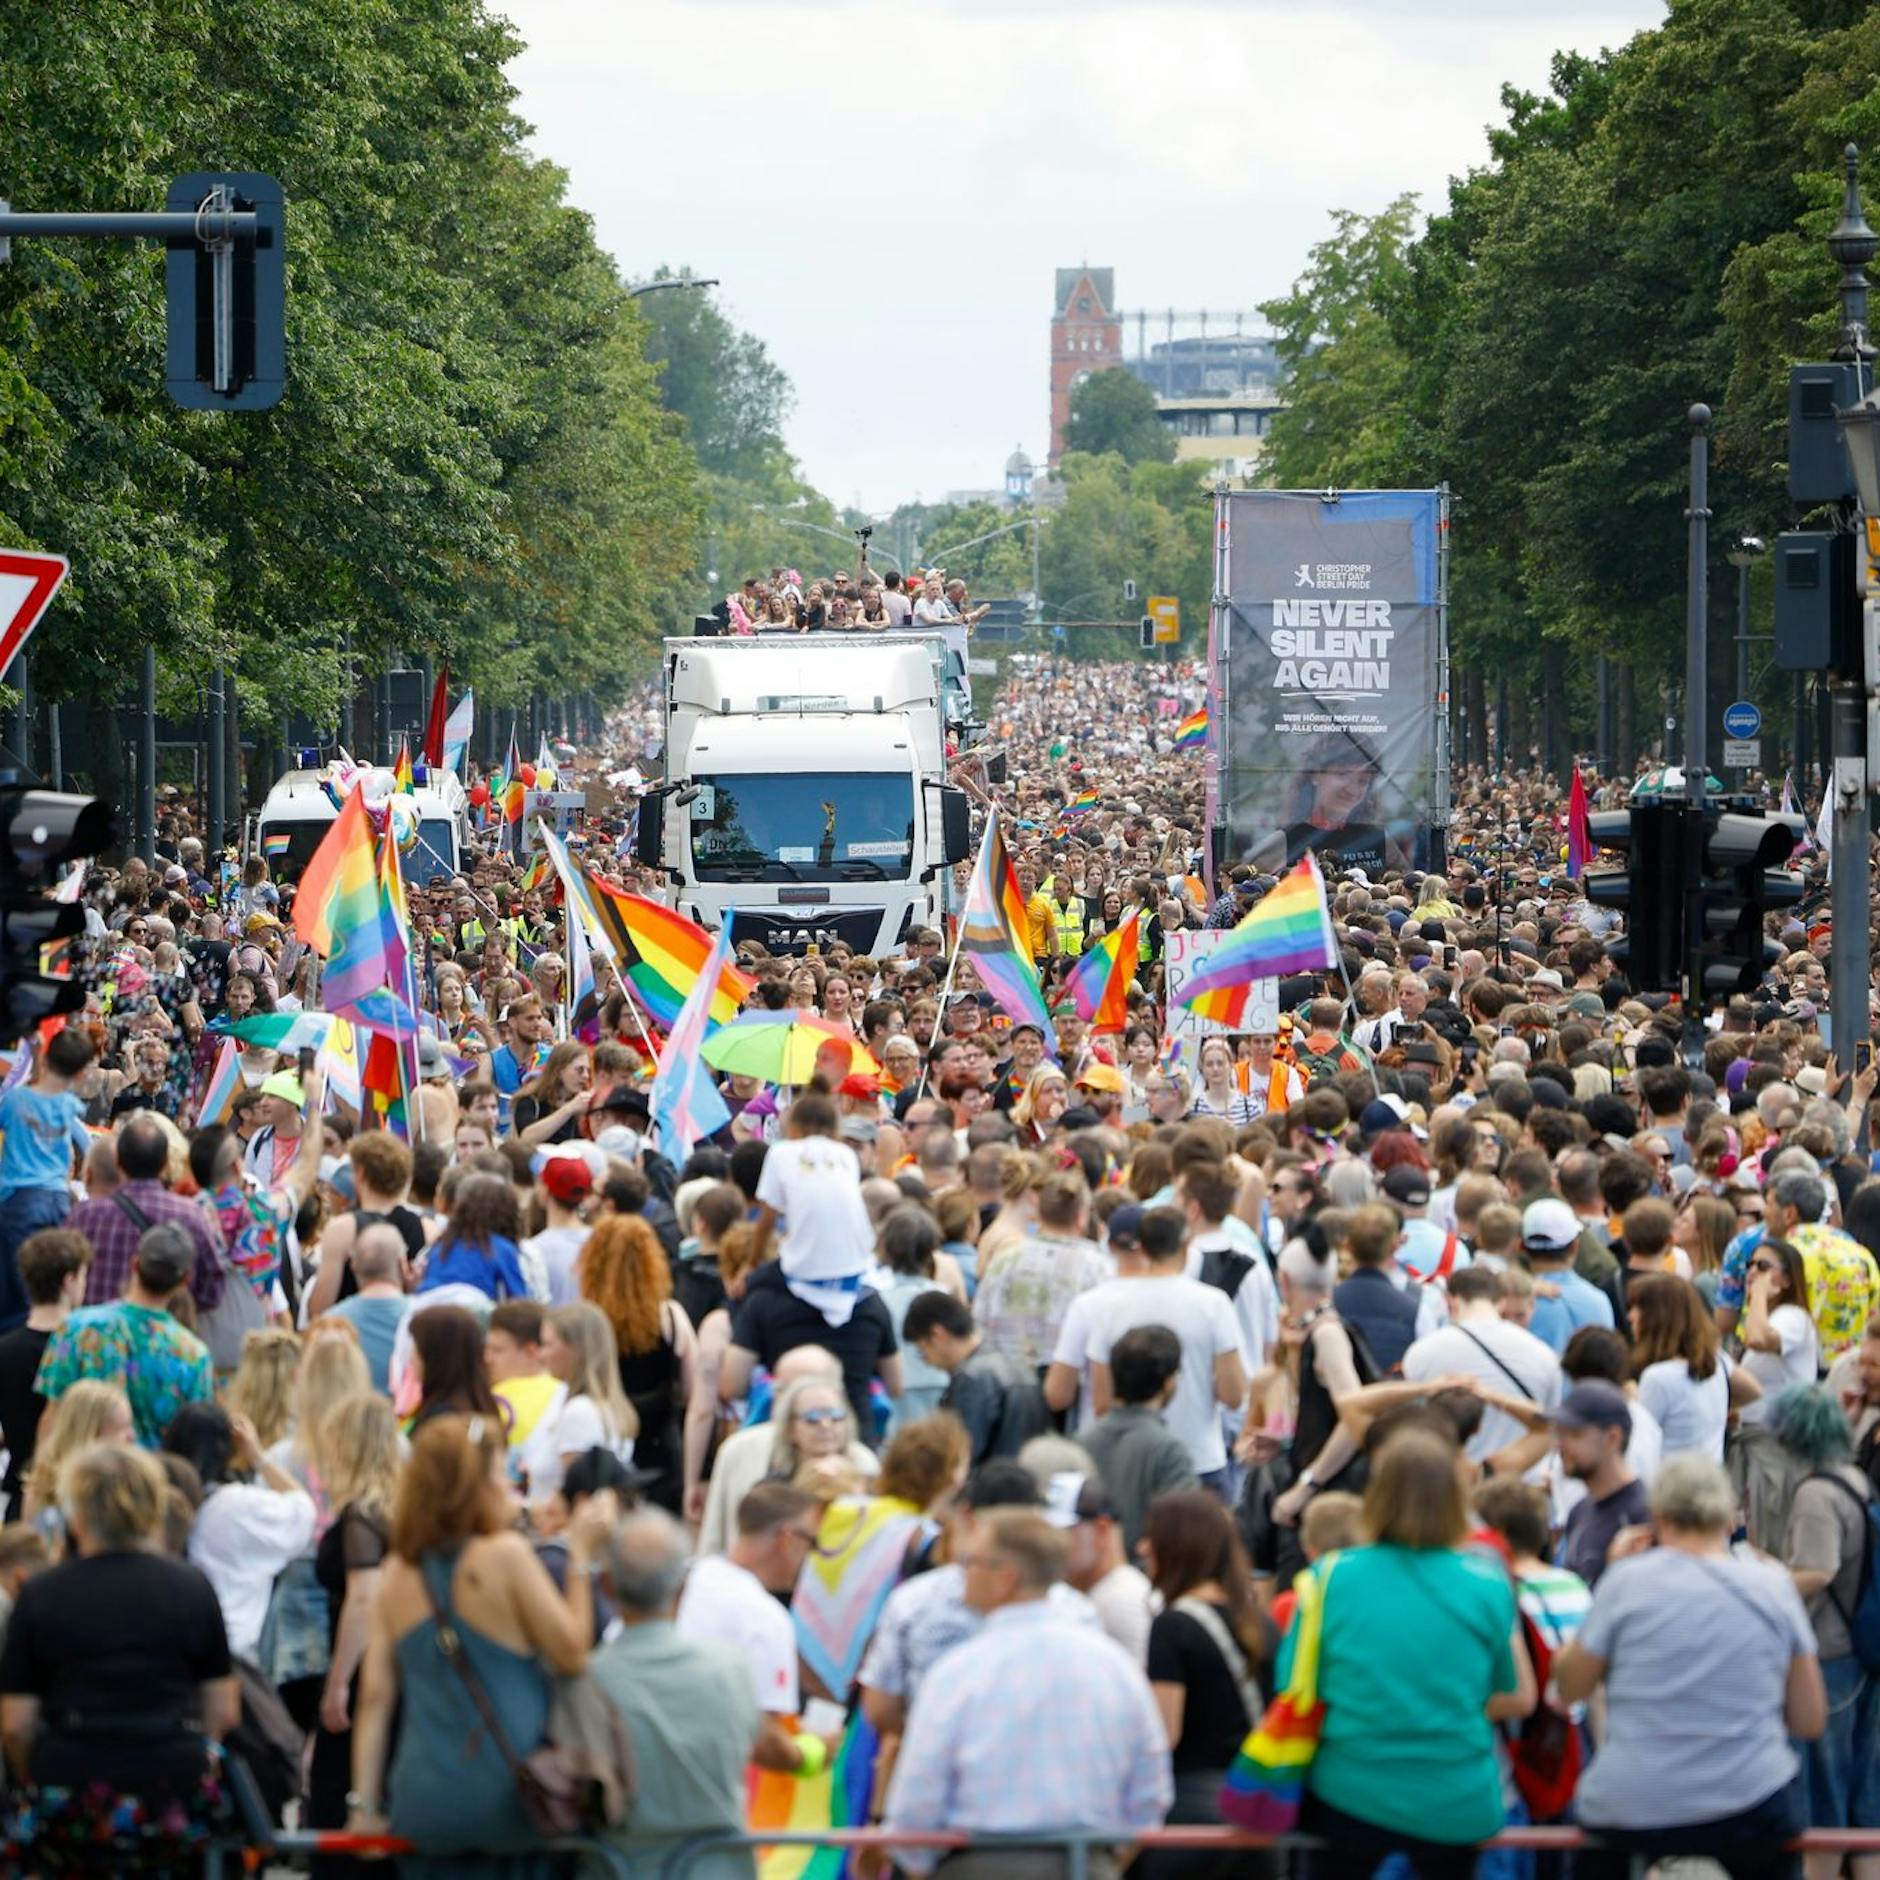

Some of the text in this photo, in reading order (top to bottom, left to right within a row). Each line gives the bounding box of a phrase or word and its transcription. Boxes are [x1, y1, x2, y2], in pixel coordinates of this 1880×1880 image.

[1316, 564, 1371, 573] CHRISTOPHER
[1316, 572, 1365, 581] STREET DAY
[1316, 580, 1371, 589] BERLIN PRIDE
[1273, 599, 1392, 628] NEVER
[1270, 629, 1394, 658] SILENT
[1273, 660, 1390, 689] AGAIN
[1283, 714, 1301, 722] WIR
[1302, 712, 1333, 722] HÖREN
[1334, 714, 1360, 723] NICHT
[1275, 723, 1290, 732] BIS
[1291, 724, 1312, 733] ALLE
[1312, 721, 1348, 733] GEHÖRT
[699, 802, 707, 815] 3
[767, 928, 839, 945] MAN
